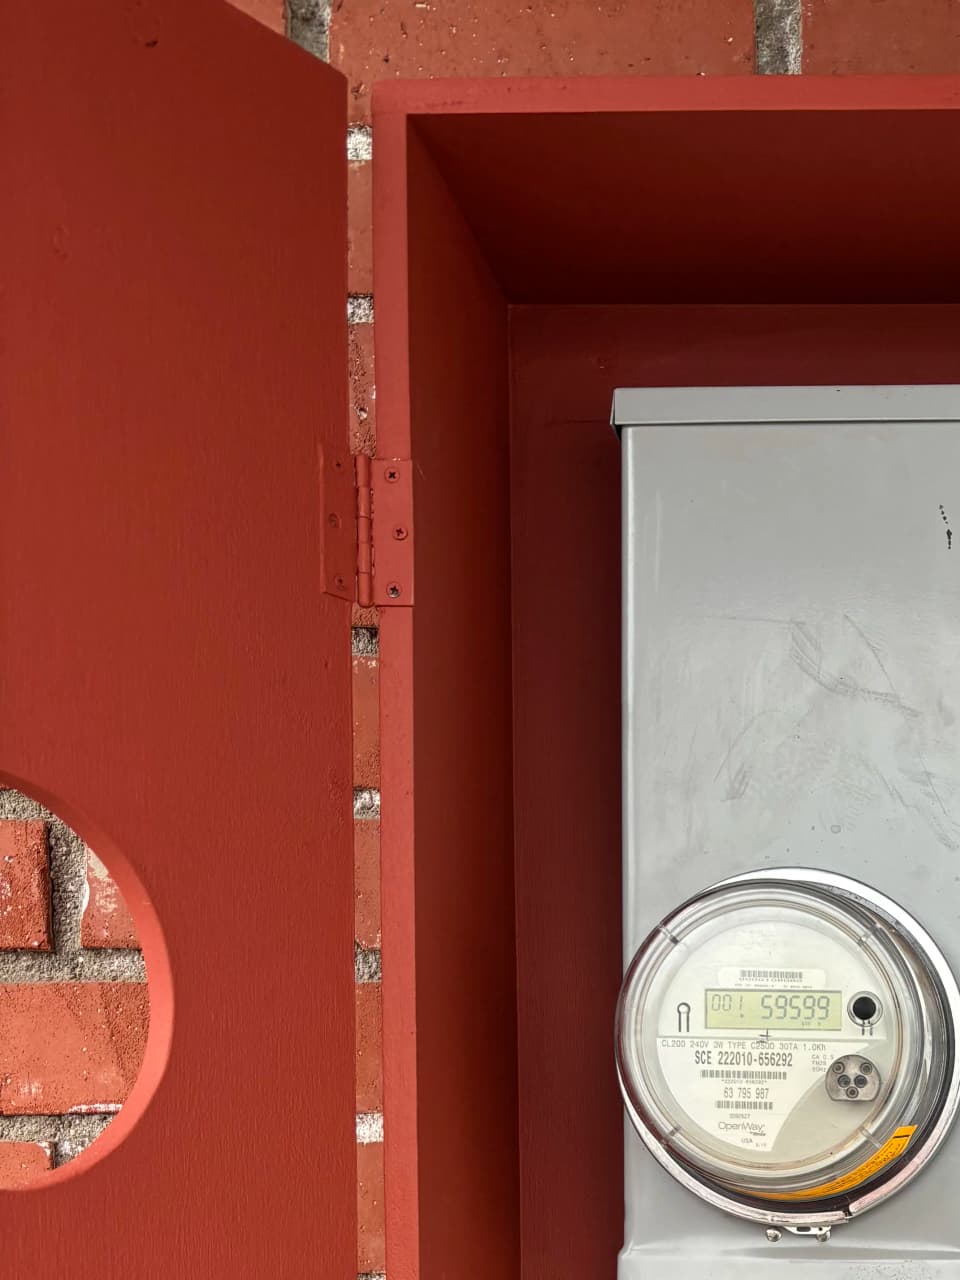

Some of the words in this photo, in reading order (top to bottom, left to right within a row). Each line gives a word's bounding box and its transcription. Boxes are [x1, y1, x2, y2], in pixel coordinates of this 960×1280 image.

[761, 995, 830, 1020] 59599
[662, 1040, 686, 1048] CL200
[690, 1040, 709, 1048] 240V
[694, 1051, 712, 1065] SCE
[718, 1052, 793, 1067] 222010-656292
[724, 1087, 734, 1098] 63
[738, 1087, 751, 1099] 795
[718, 1121, 763, 1132] OpenWay
